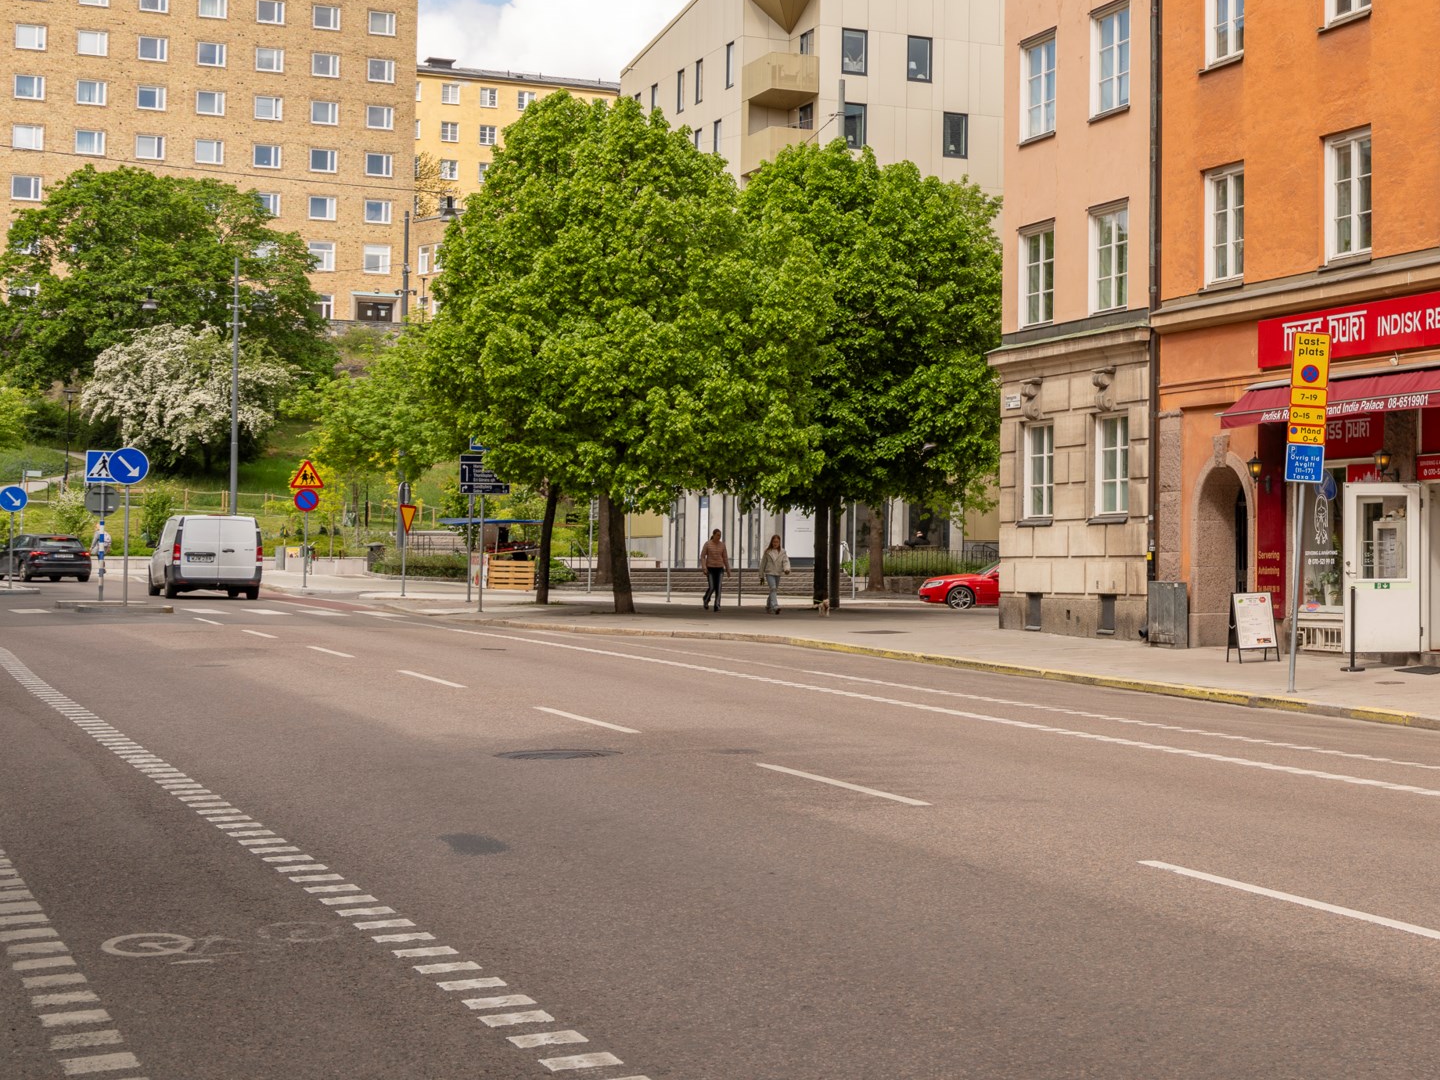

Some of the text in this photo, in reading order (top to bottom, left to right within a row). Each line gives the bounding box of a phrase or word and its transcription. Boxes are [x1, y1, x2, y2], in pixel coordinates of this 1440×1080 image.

[1378, 310, 1422, 337] INDISK
[1299, 337, 1326, 345] Last-
[1299, 347, 1324, 356] plats
[1342, 401, 1358, 412] India
[1360, 400, 1384, 411] Palace
[1388, 394, 1429, 408] 08-6519901
[1261, 410, 1281, 421] Indisk
[1258, 551, 1280, 560] Servering
[1258, 566, 1280, 576] Avhämtning
